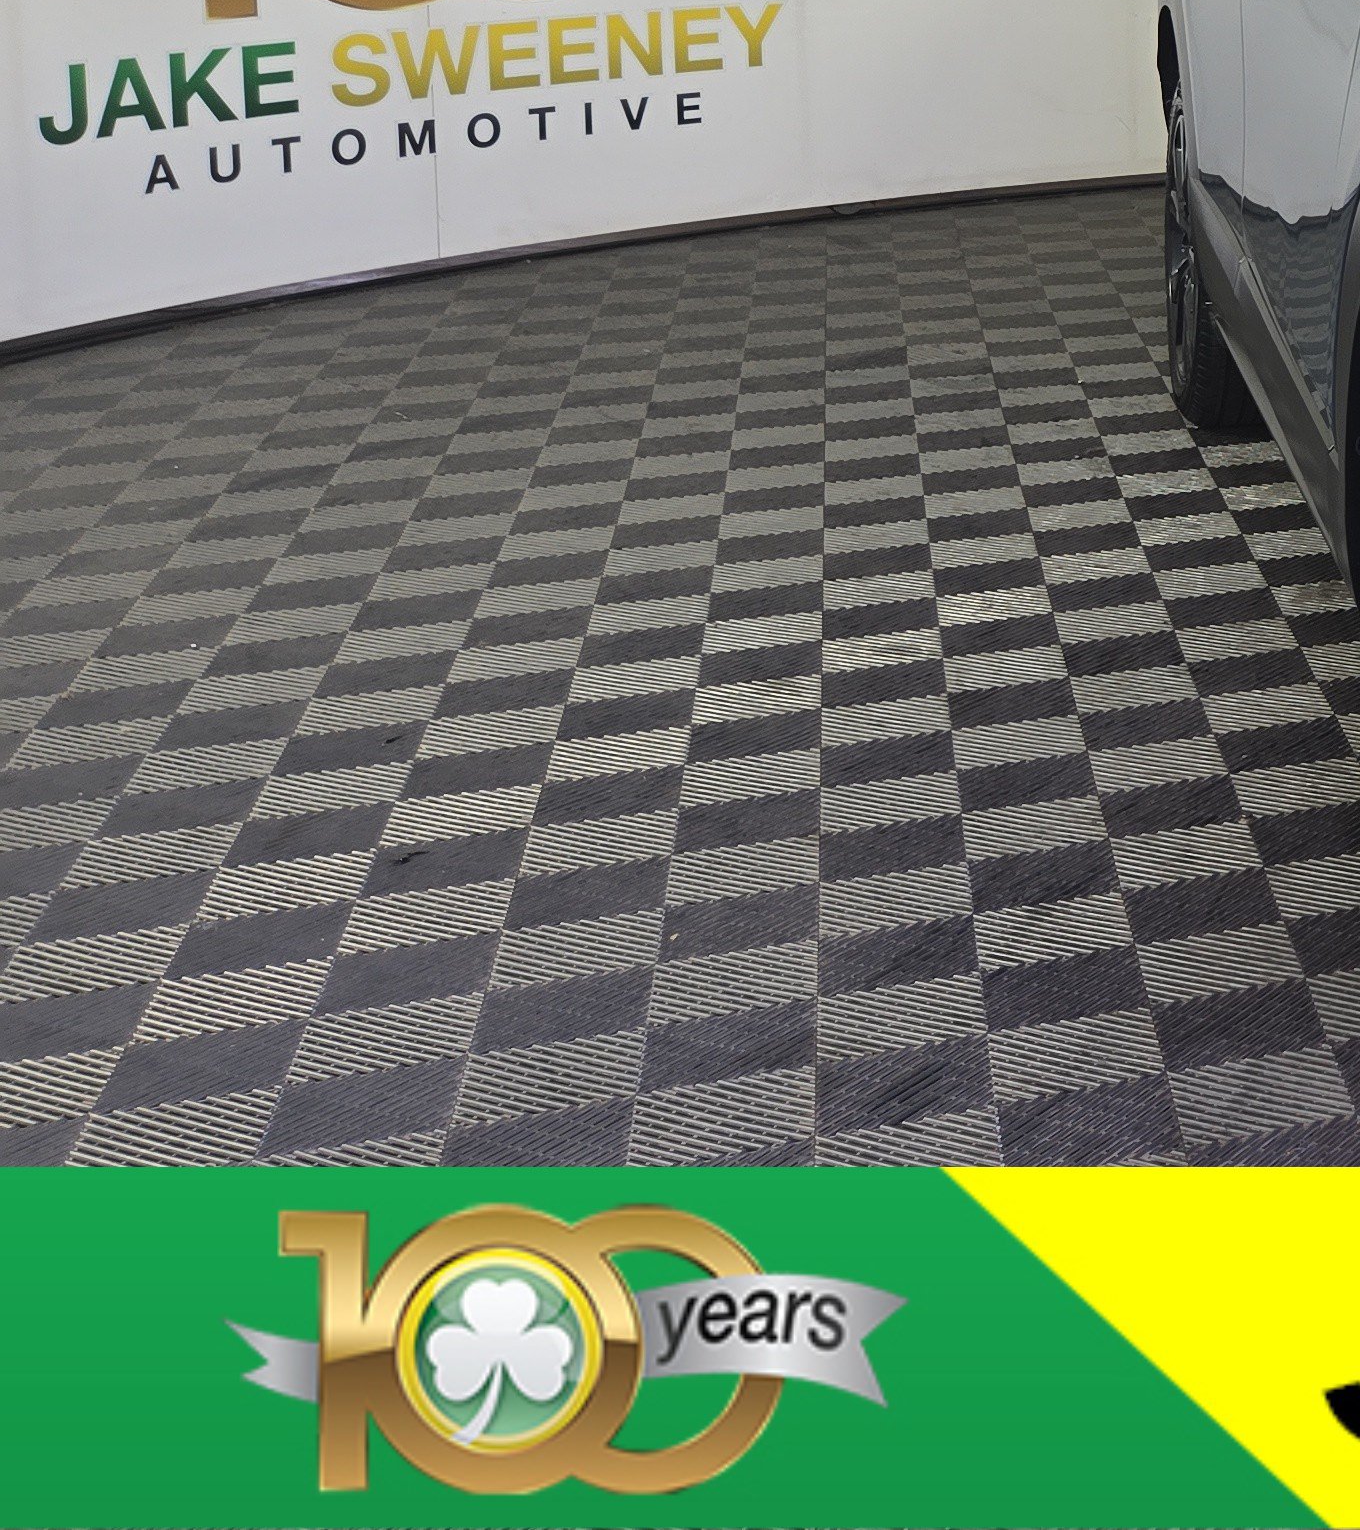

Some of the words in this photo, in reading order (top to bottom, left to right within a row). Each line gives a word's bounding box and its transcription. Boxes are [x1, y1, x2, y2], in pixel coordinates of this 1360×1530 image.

[38, 40, 300, 146] JAKE
[330, 3, 783, 108] SWEENEY
[145, 91, 703, 194] AUTOMOTIVE
